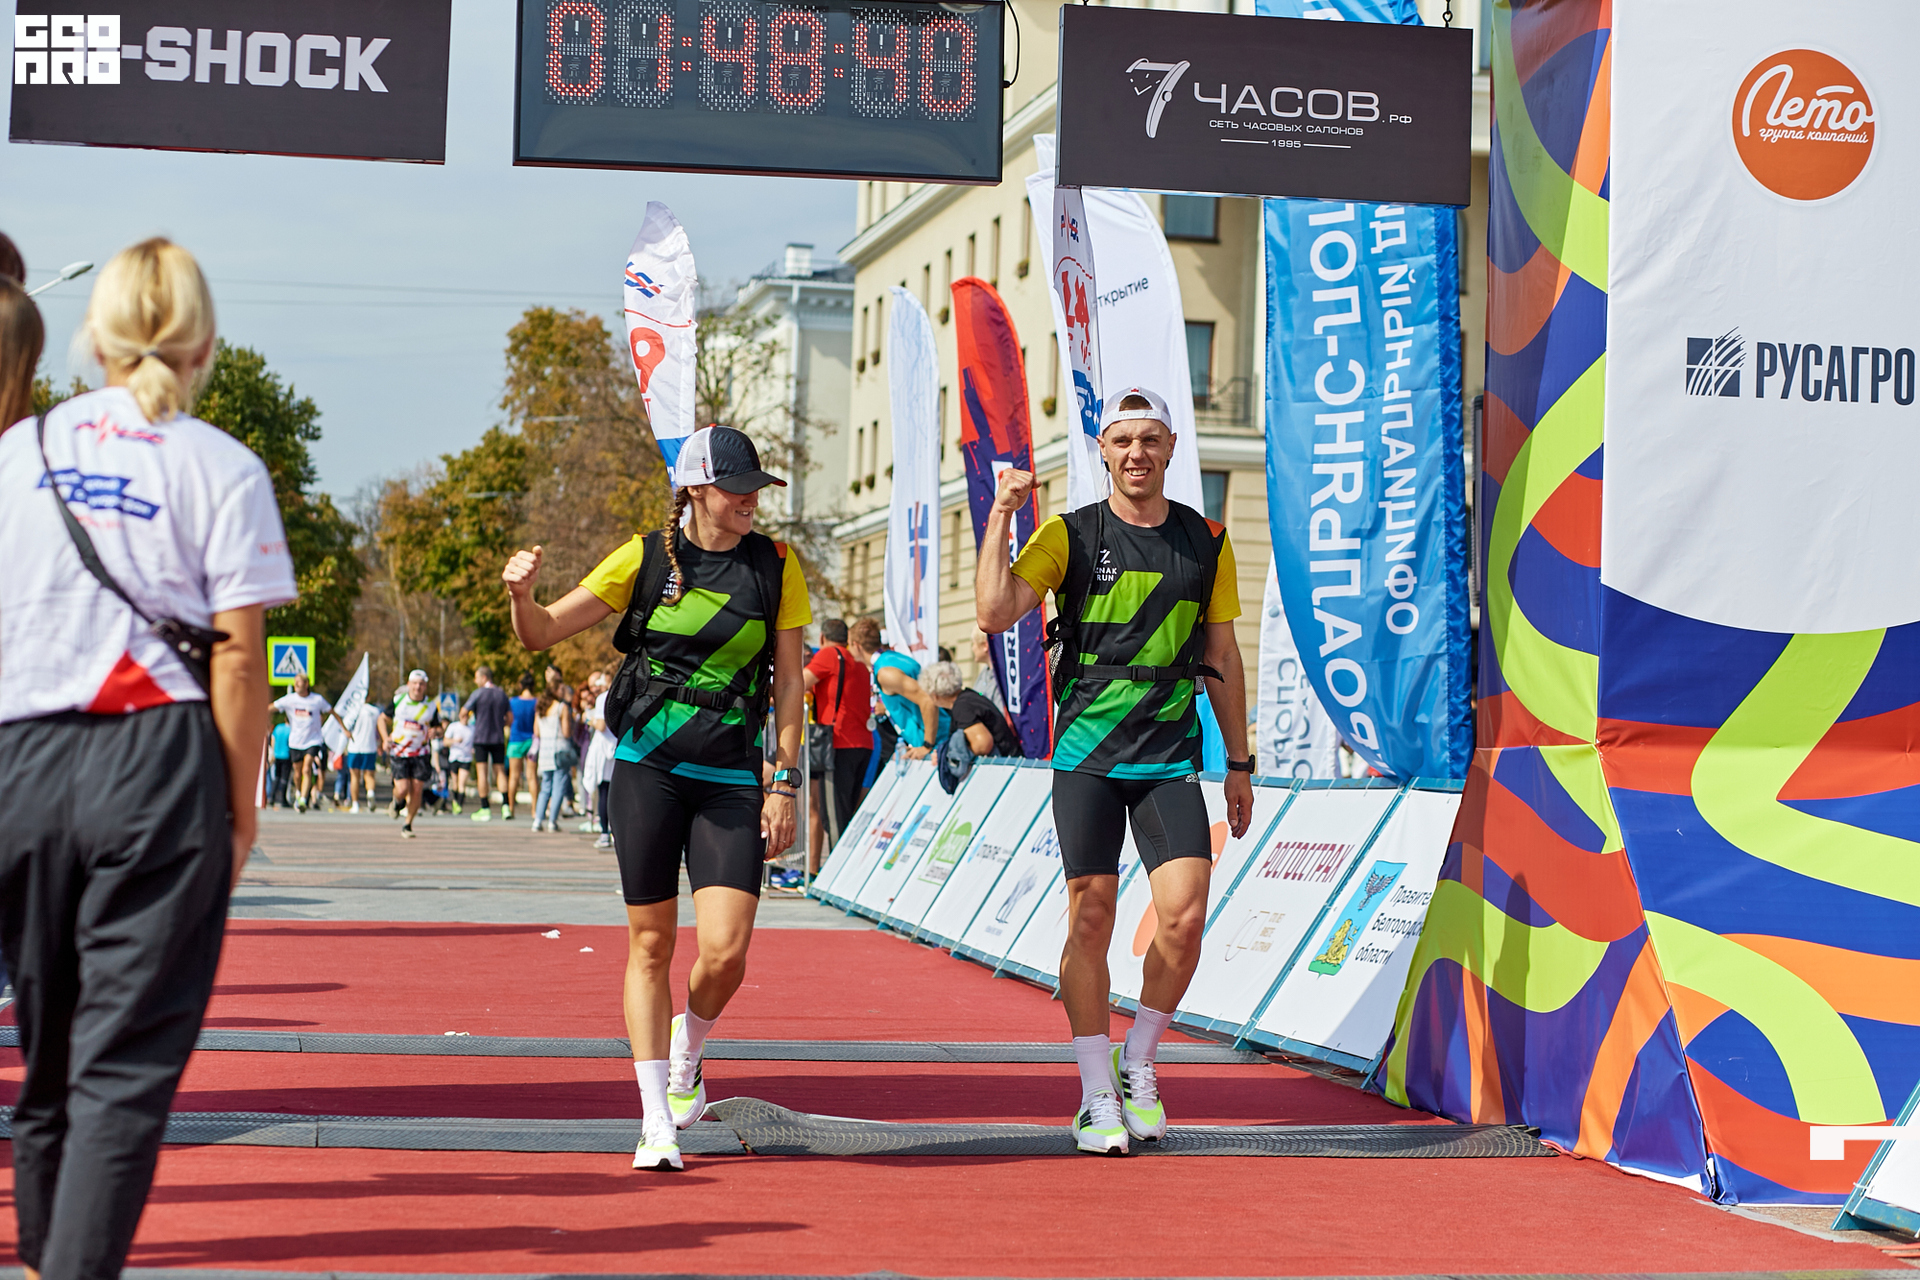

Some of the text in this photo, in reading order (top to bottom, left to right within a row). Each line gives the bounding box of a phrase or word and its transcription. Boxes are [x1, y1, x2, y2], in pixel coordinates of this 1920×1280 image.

[84, 22, 391, 93] -SHOCK
[549, 1, 976, 113] 01:48:40
[1209, 119, 1364, 136] СЕТЬ ЧАСОВЫХ САЛОНОВ
[1759, 128, 1805, 143] группа
[1271, 139, 1302, 148] 1995
[1096, 277, 1149, 307] ткрытие
[1756, 342, 1916, 406] РУСАГРО
[1096, 574, 1114, 582] RUN
[1256, 841, 1356, 883] РОСГОССТРАХ
[1390, 885, 1433, 908] Правите
[1354, 942, 1394, 966] области
